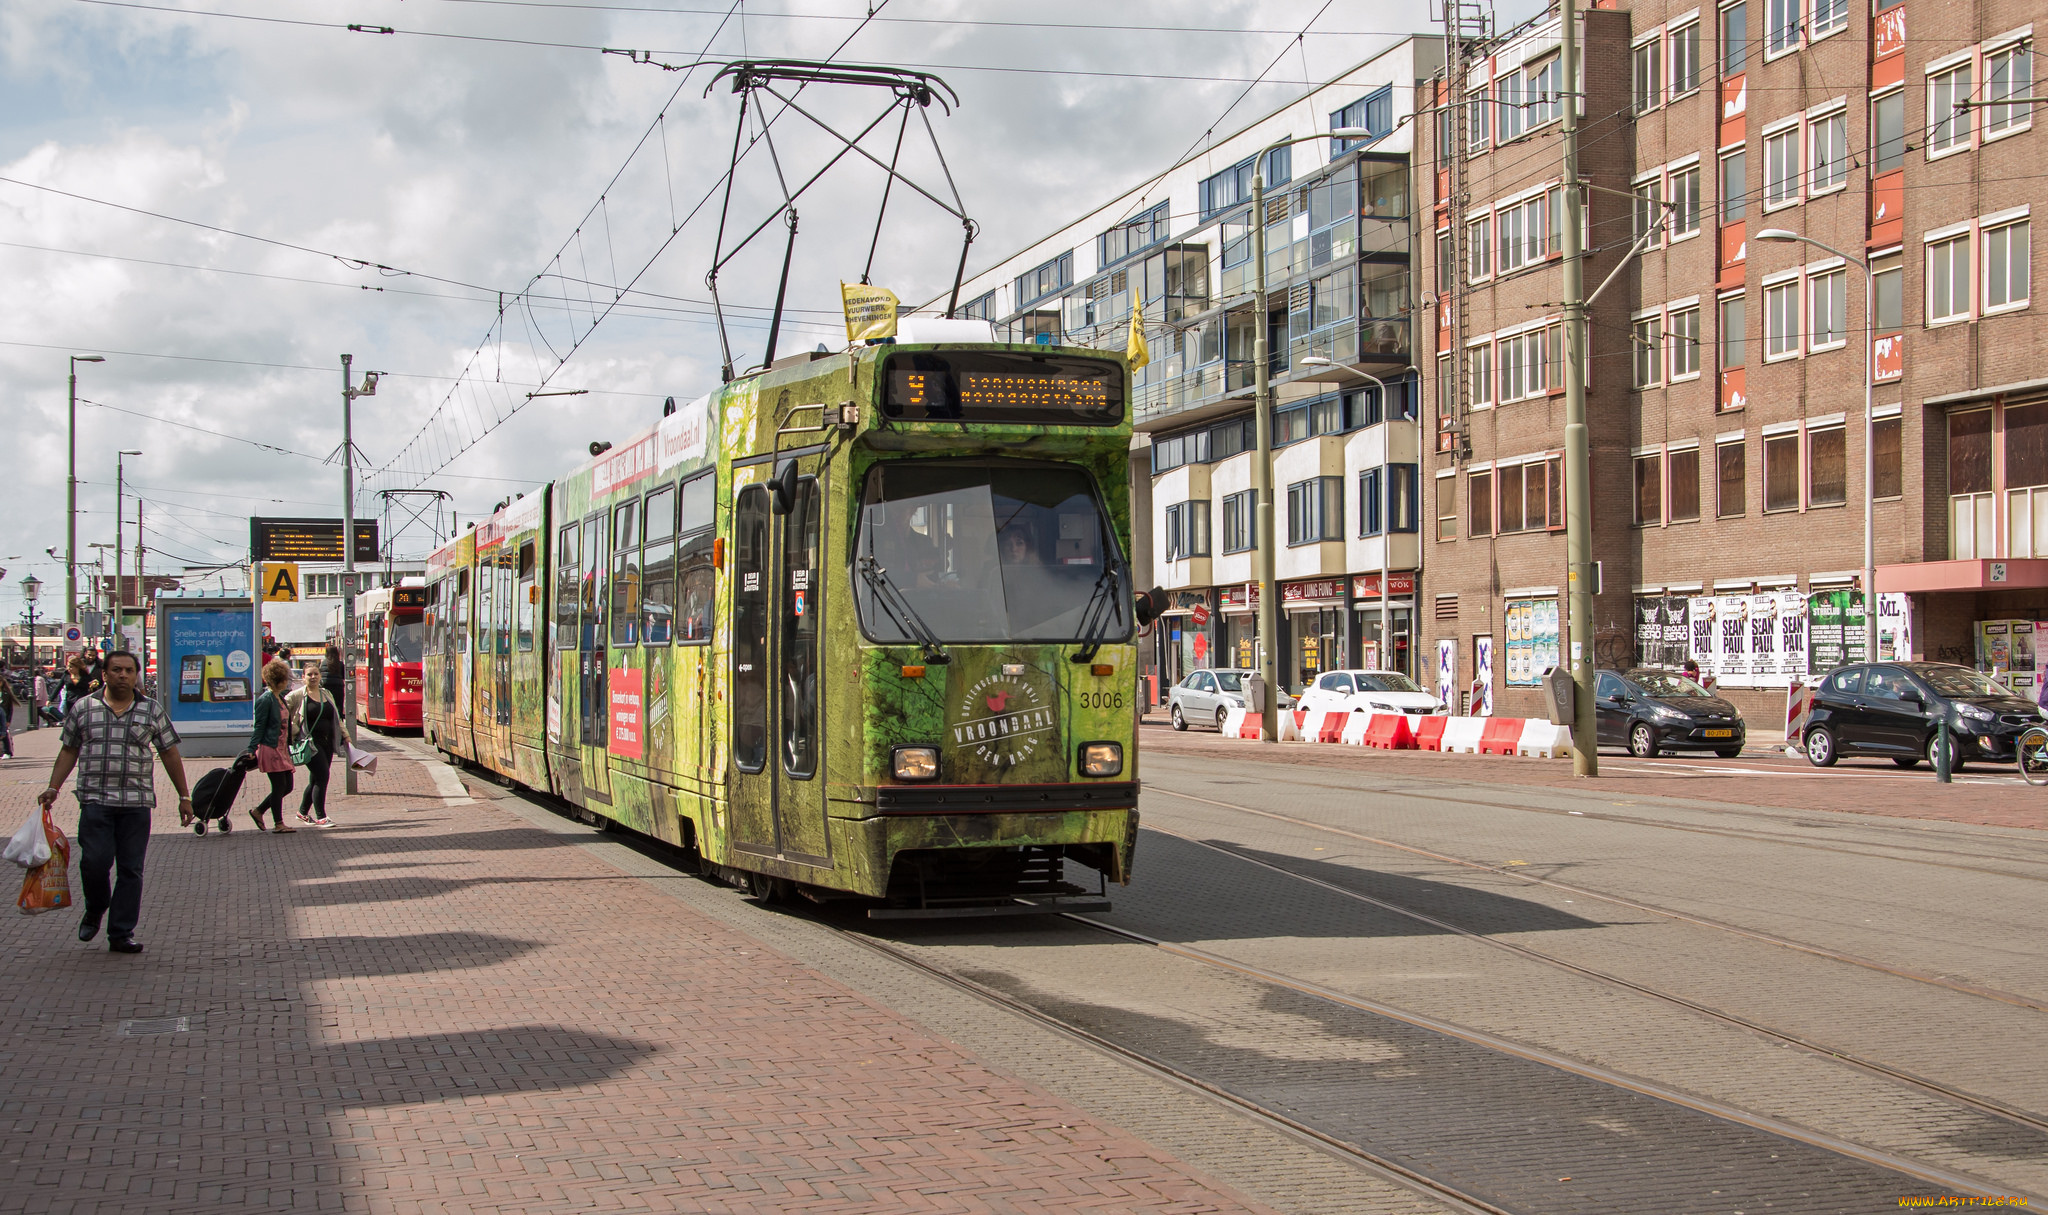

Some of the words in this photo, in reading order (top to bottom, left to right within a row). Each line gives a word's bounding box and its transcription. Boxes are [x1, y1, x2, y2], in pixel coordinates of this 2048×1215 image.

[845, 313, 893, 323] HEVENINGEN
[847, 304, 886, 315] VUURWERK
[664, 417, 700, 459] Vroondaal.nl
[269, 568, 298, 597] A
[1304, 583, 1318, 597] LUNG
[1319, 582, 1333, 596] FUNG
[398, 593, 409, 602] 20
[1879, 601, 1900, 617] ML
[1693, 619, 1712, 637] SEAN
[1722, 619, 1745, 637] SEAN
[1751, 617, 1774, 636] SEAN
[1782, 615, 1804, 634] SEAN
[174, 629, 197, 638] Snelle
[198, 629, 246, 639] smartphone.
[174, 638, 206, 648] Scherpe
[207, 638, 225, 648] prijs.
[1637, 631, 1662, 639] ZERO
[1663, 632, 1688, 641] ZERO
[290, 647, 327, 656] ESTAURAN
[1694, 636, 1713, 654] PAUL
[1723, 636, 1745, 654] PAUL
[1752, 635, 1775, 654] PAUL
[1022, 682, 1040, 704] VRIJ
[1079, 692, 1123, 709] 3006
[954, 710, 1053, 743] VROONDAAL
[976, 745, 1000, 766] DEN
[1008, 737, 1038, 766] HAAG
